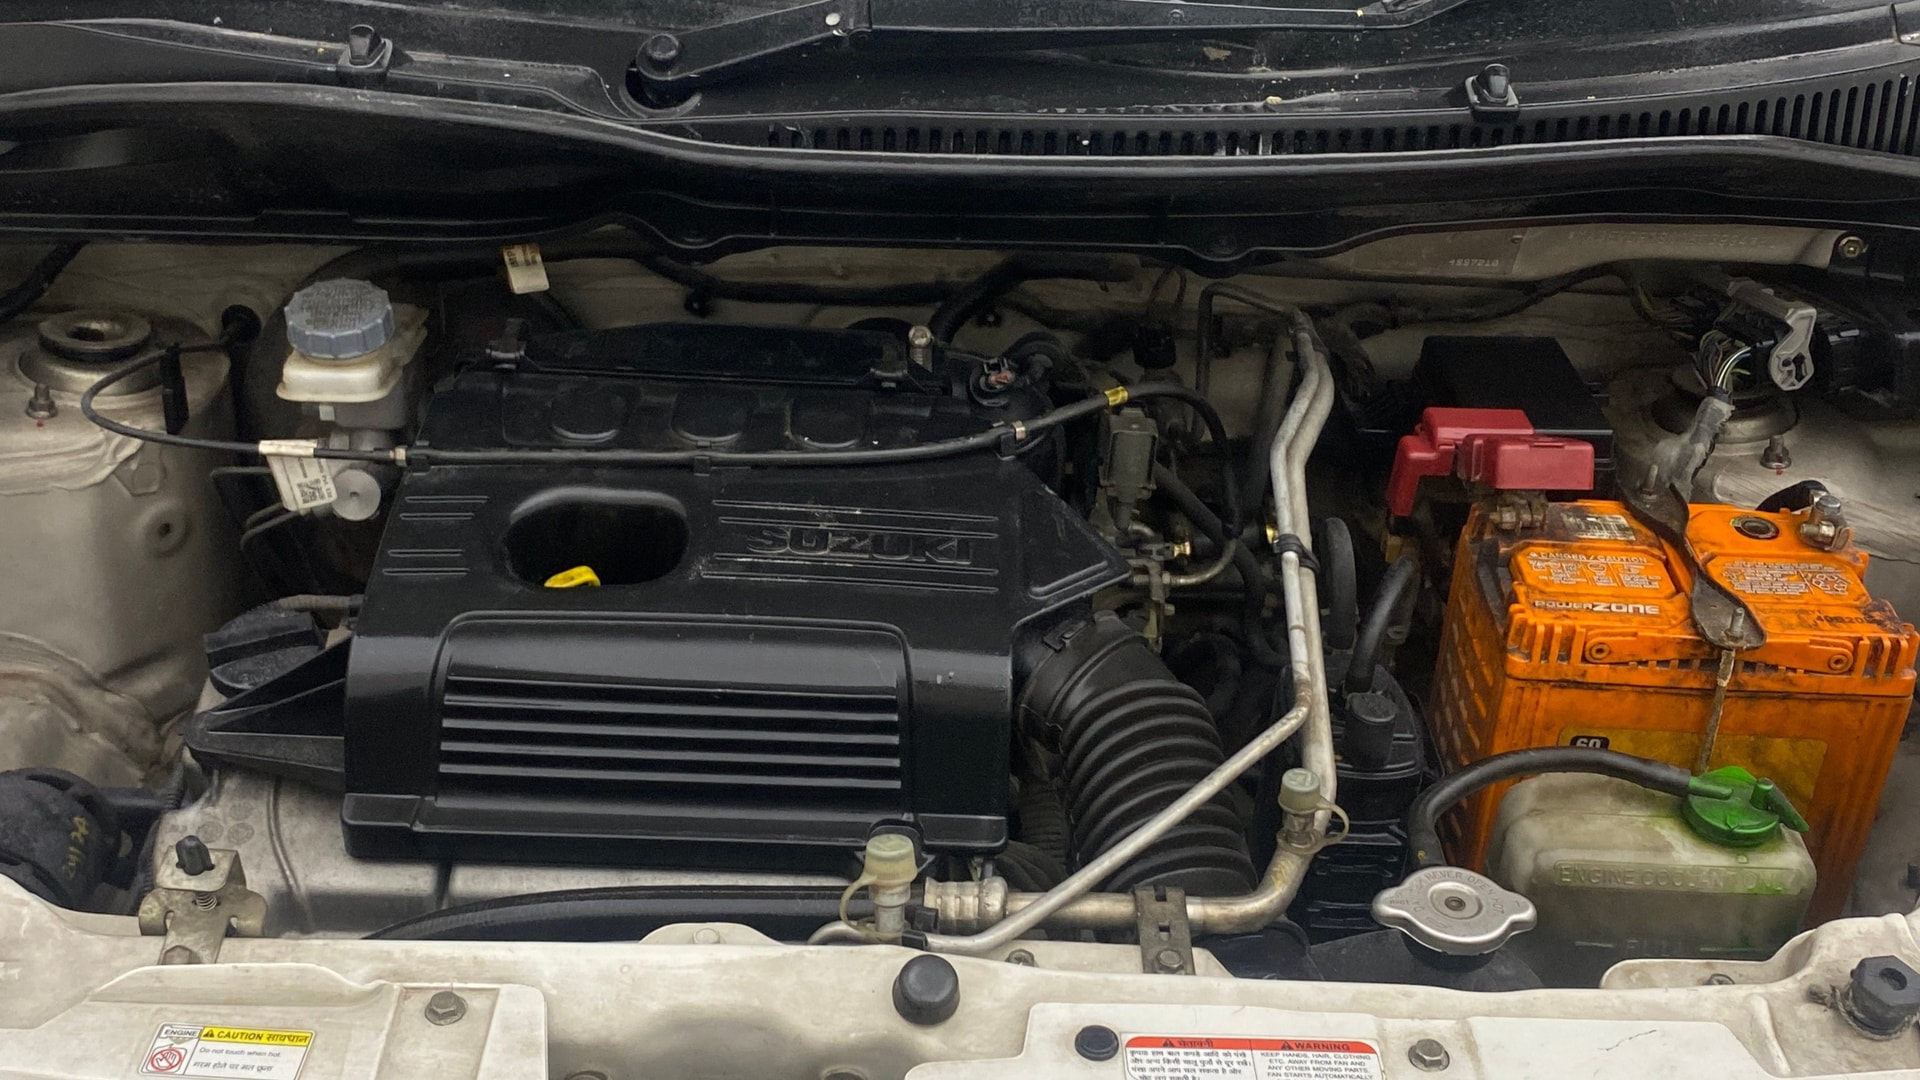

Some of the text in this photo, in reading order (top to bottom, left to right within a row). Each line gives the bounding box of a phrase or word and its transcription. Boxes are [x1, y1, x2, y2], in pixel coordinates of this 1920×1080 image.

[747, 527, 972, 565] SUZUKI
[1539, 552, 1586, 561] DANGER
[1424, 871, 1463, 882] NEVER
[1559, 864, 1636, 886] ENGINE
[164, 1029, 198, 1037] ENGINE
[217, 1031, 264, 1041] CAUTION
[266, 1033, 309, 1044] सावधान
[1294, 1042, 1350, 1051] WARNING
